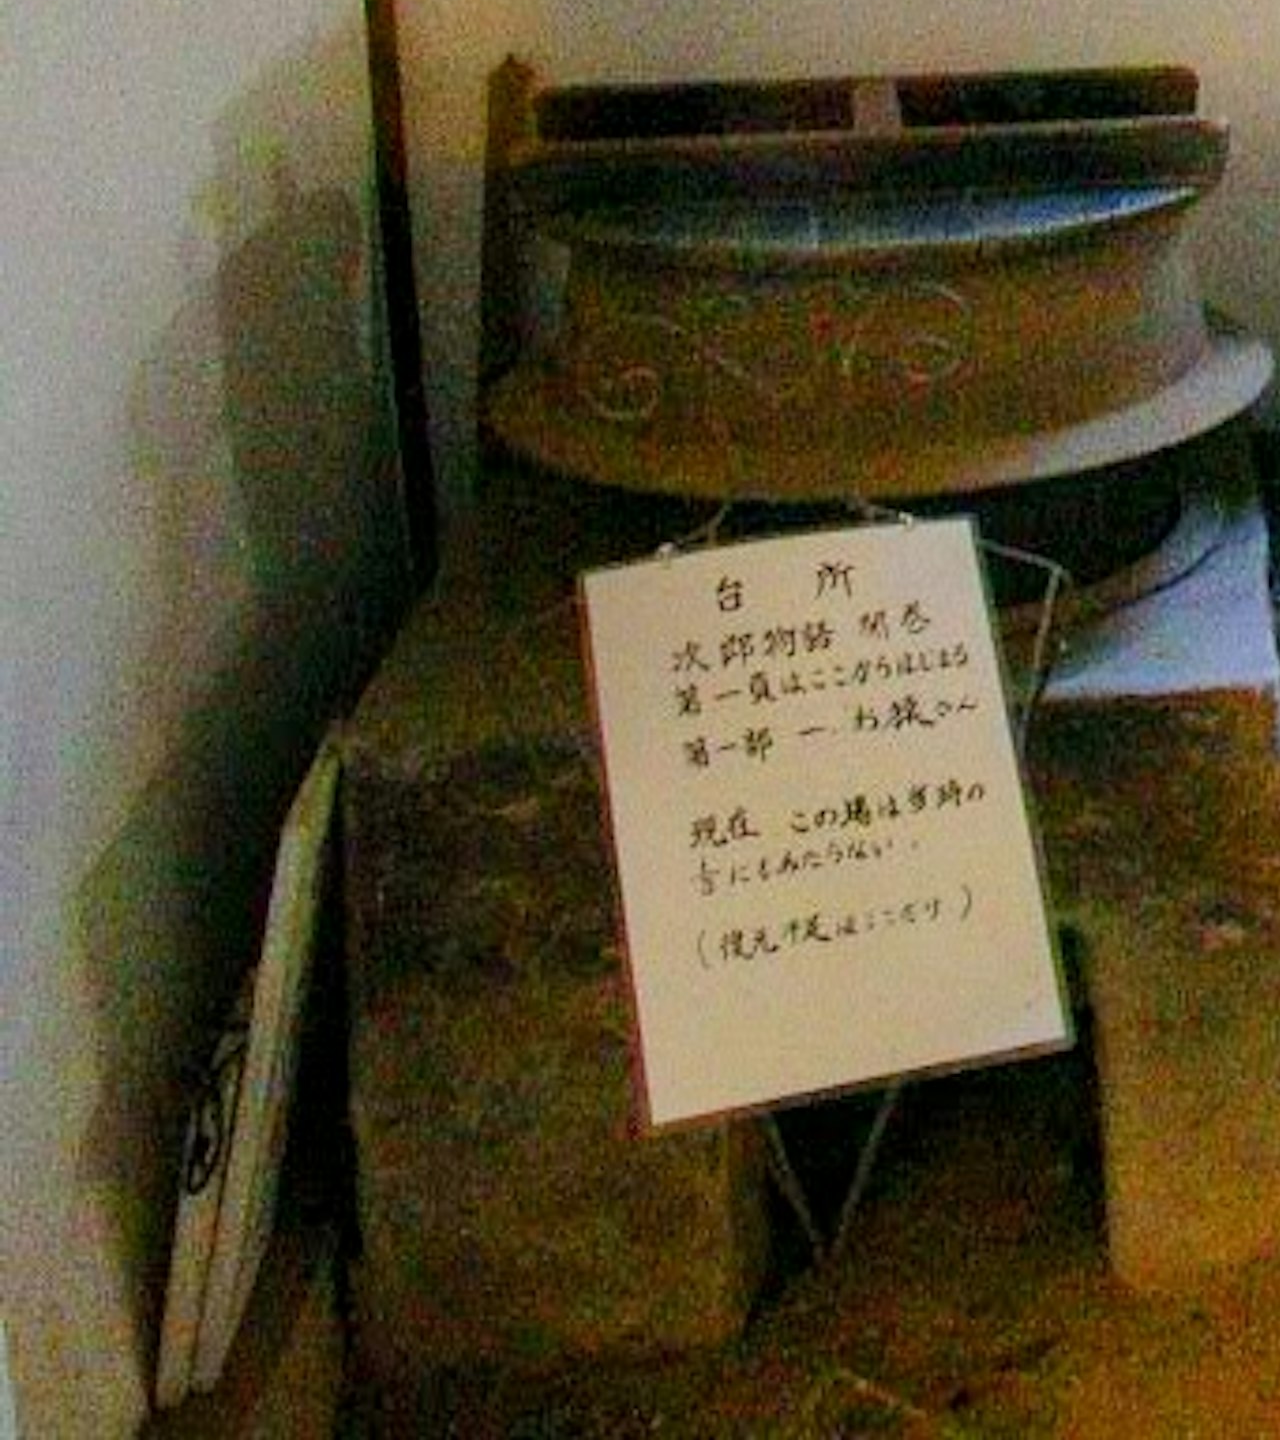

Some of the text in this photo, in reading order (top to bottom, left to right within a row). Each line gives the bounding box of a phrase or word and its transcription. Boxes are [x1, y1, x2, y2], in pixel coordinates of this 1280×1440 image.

[716, 560, 856, 612] 台所
[671, 619, 836, 673] 次郎物語
[689, 805, 762, 848] 現在
